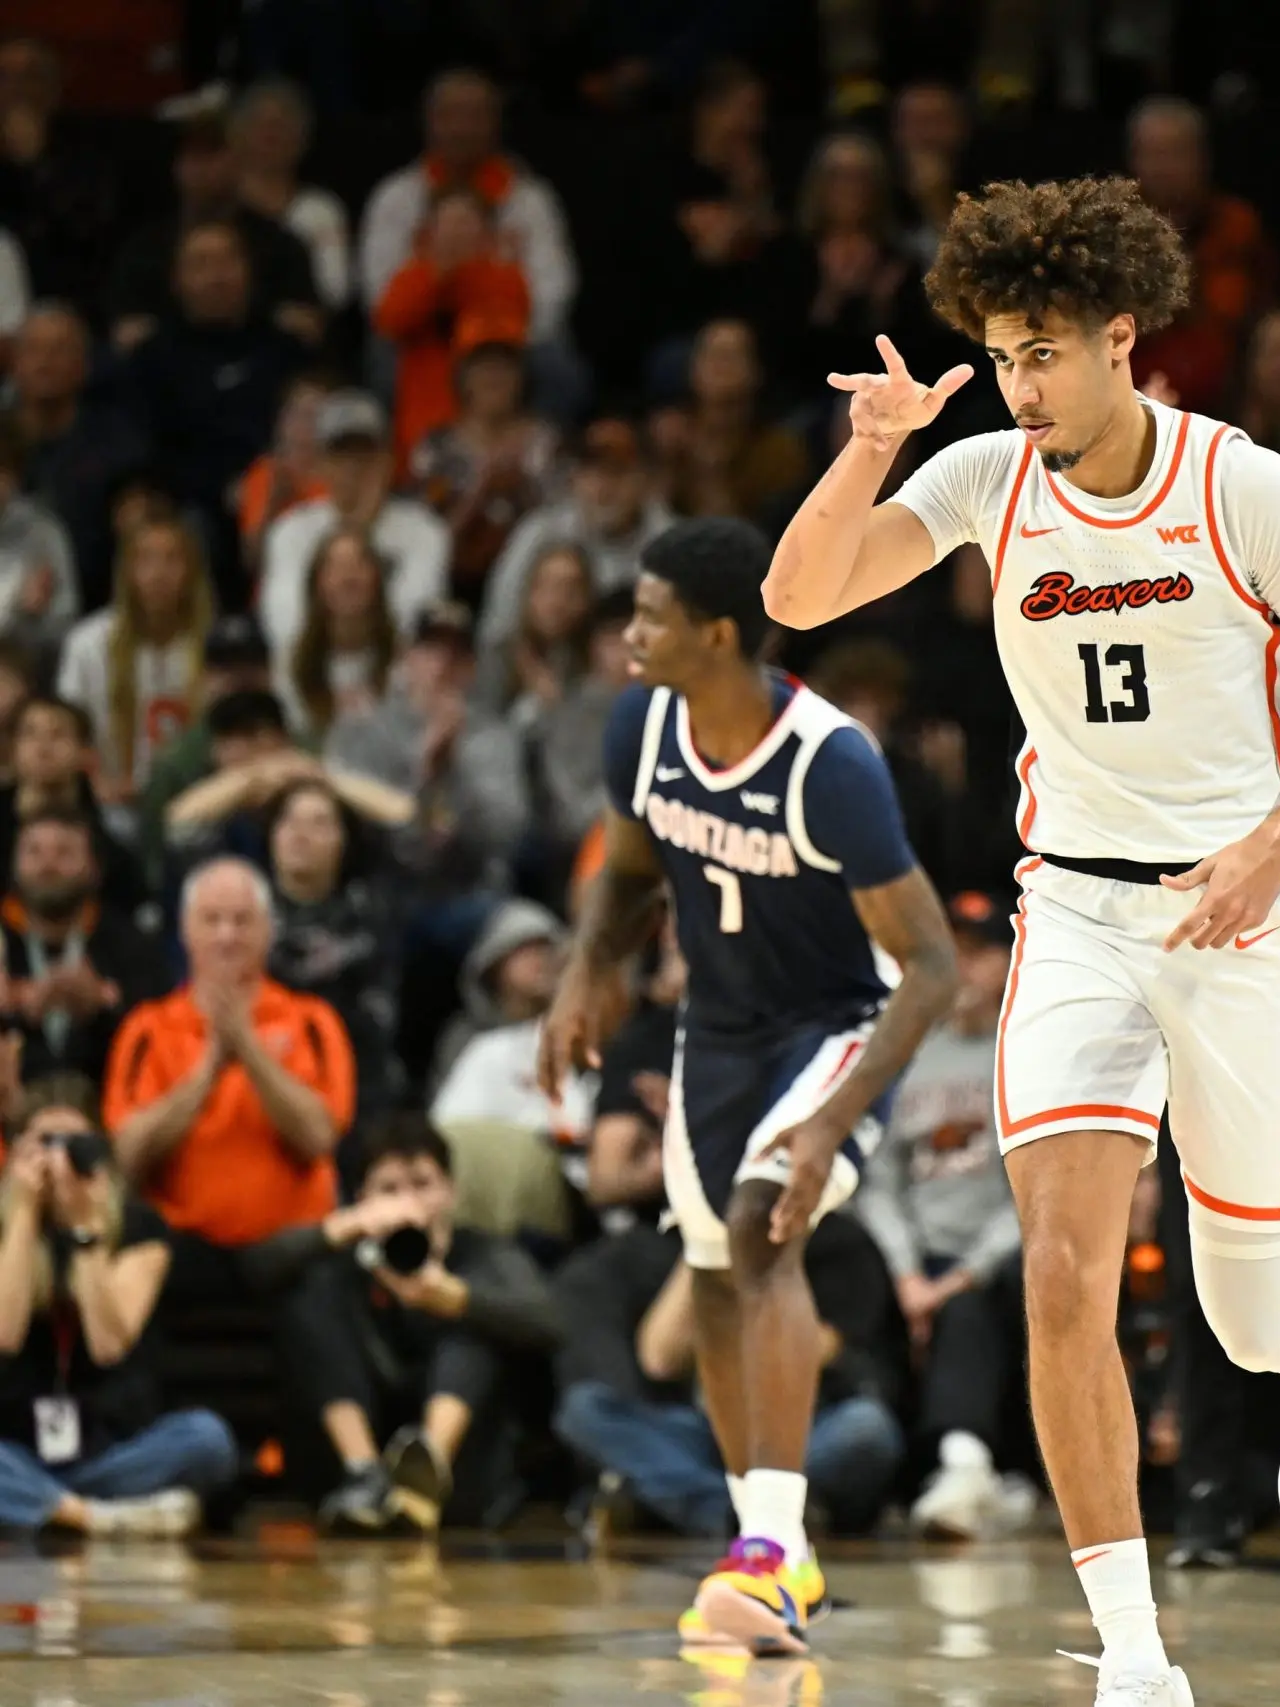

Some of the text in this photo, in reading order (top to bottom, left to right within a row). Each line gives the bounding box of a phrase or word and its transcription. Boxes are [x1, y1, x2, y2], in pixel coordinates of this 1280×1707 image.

[1156, 524, 1200, 545] WCC
[1020, 571, 1194, 622] Beavers
[1077, 643, 1151, 723] 13
[646, 792, 799, 877] GONZAGA
[703, 863, 743, 933] 7
